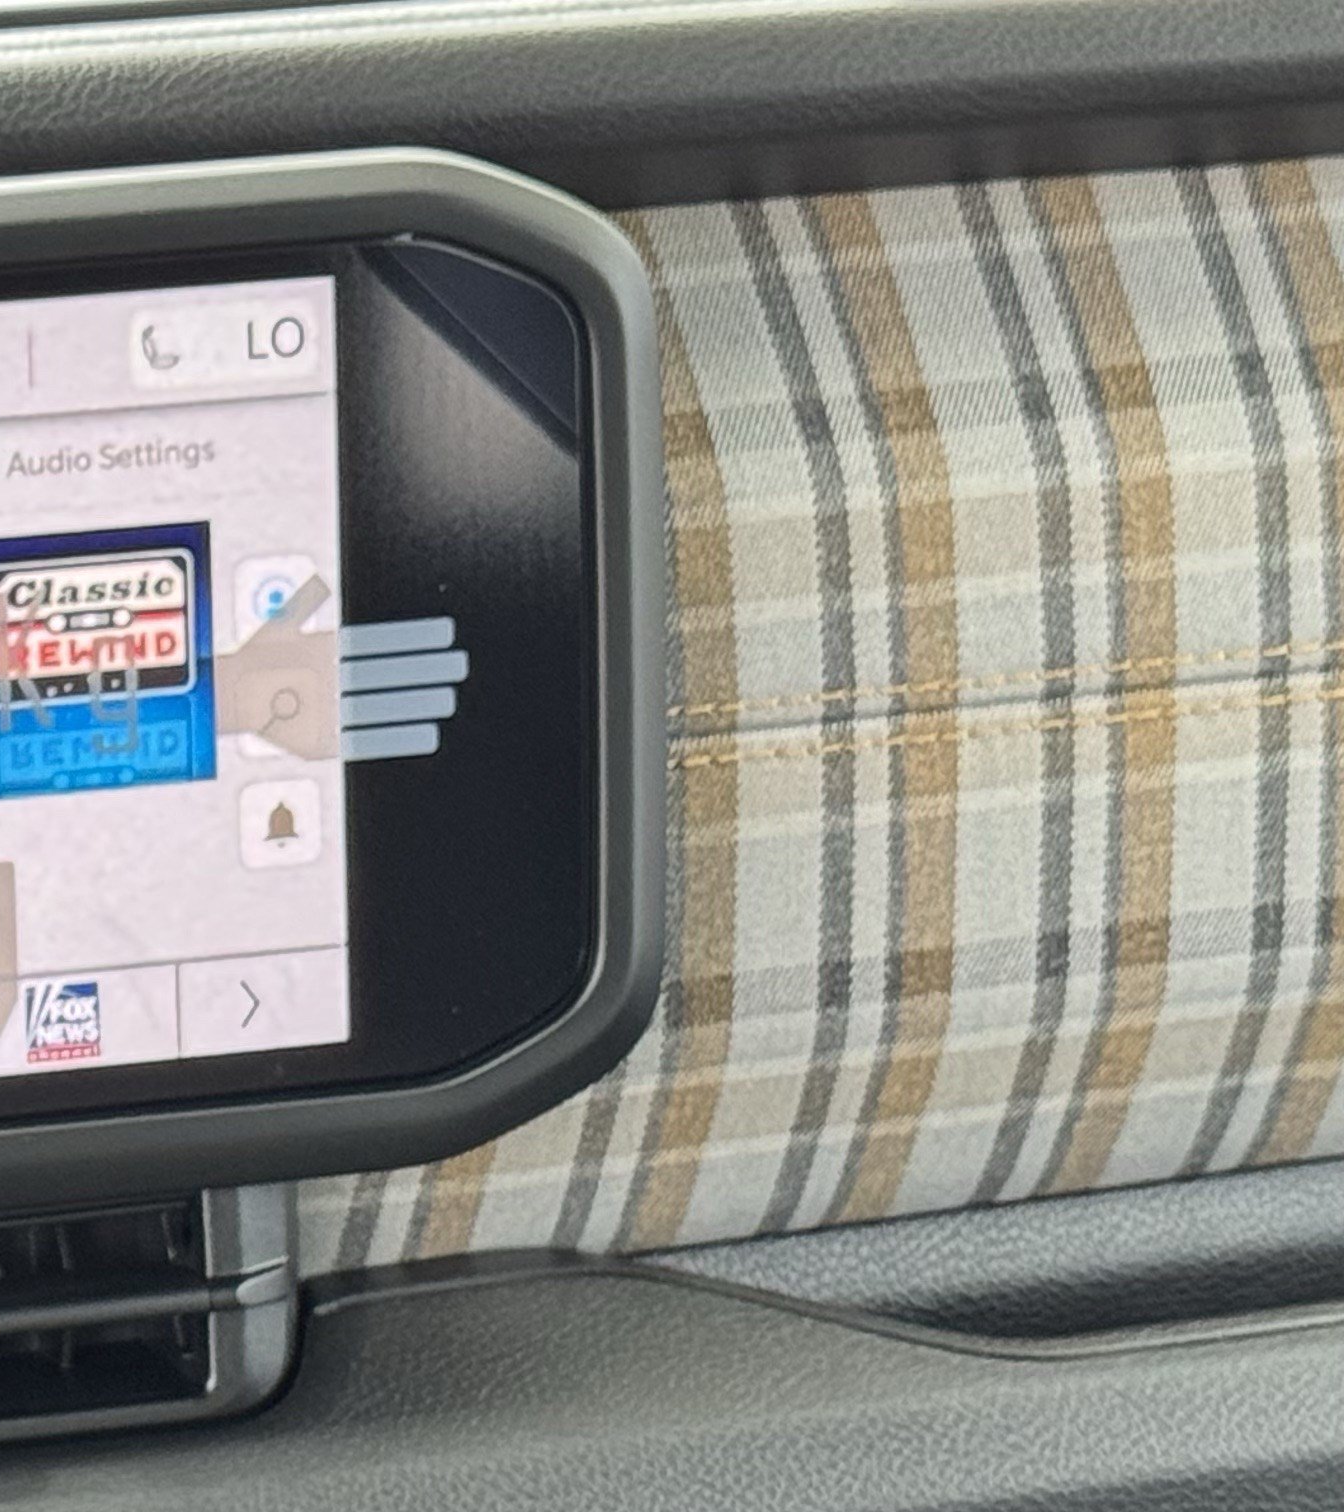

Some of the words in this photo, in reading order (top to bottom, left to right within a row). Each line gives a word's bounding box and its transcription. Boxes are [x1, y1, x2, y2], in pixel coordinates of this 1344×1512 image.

[247, 315, 306, 361] LO
[5, 448, 93, 479] Audio
[98, 437, 217, 472] Settings
[6, 571, 175, 608] Classic
[48, 996, 98, 1024] FOX
[35, 1020, 99, 1046] NEWS
